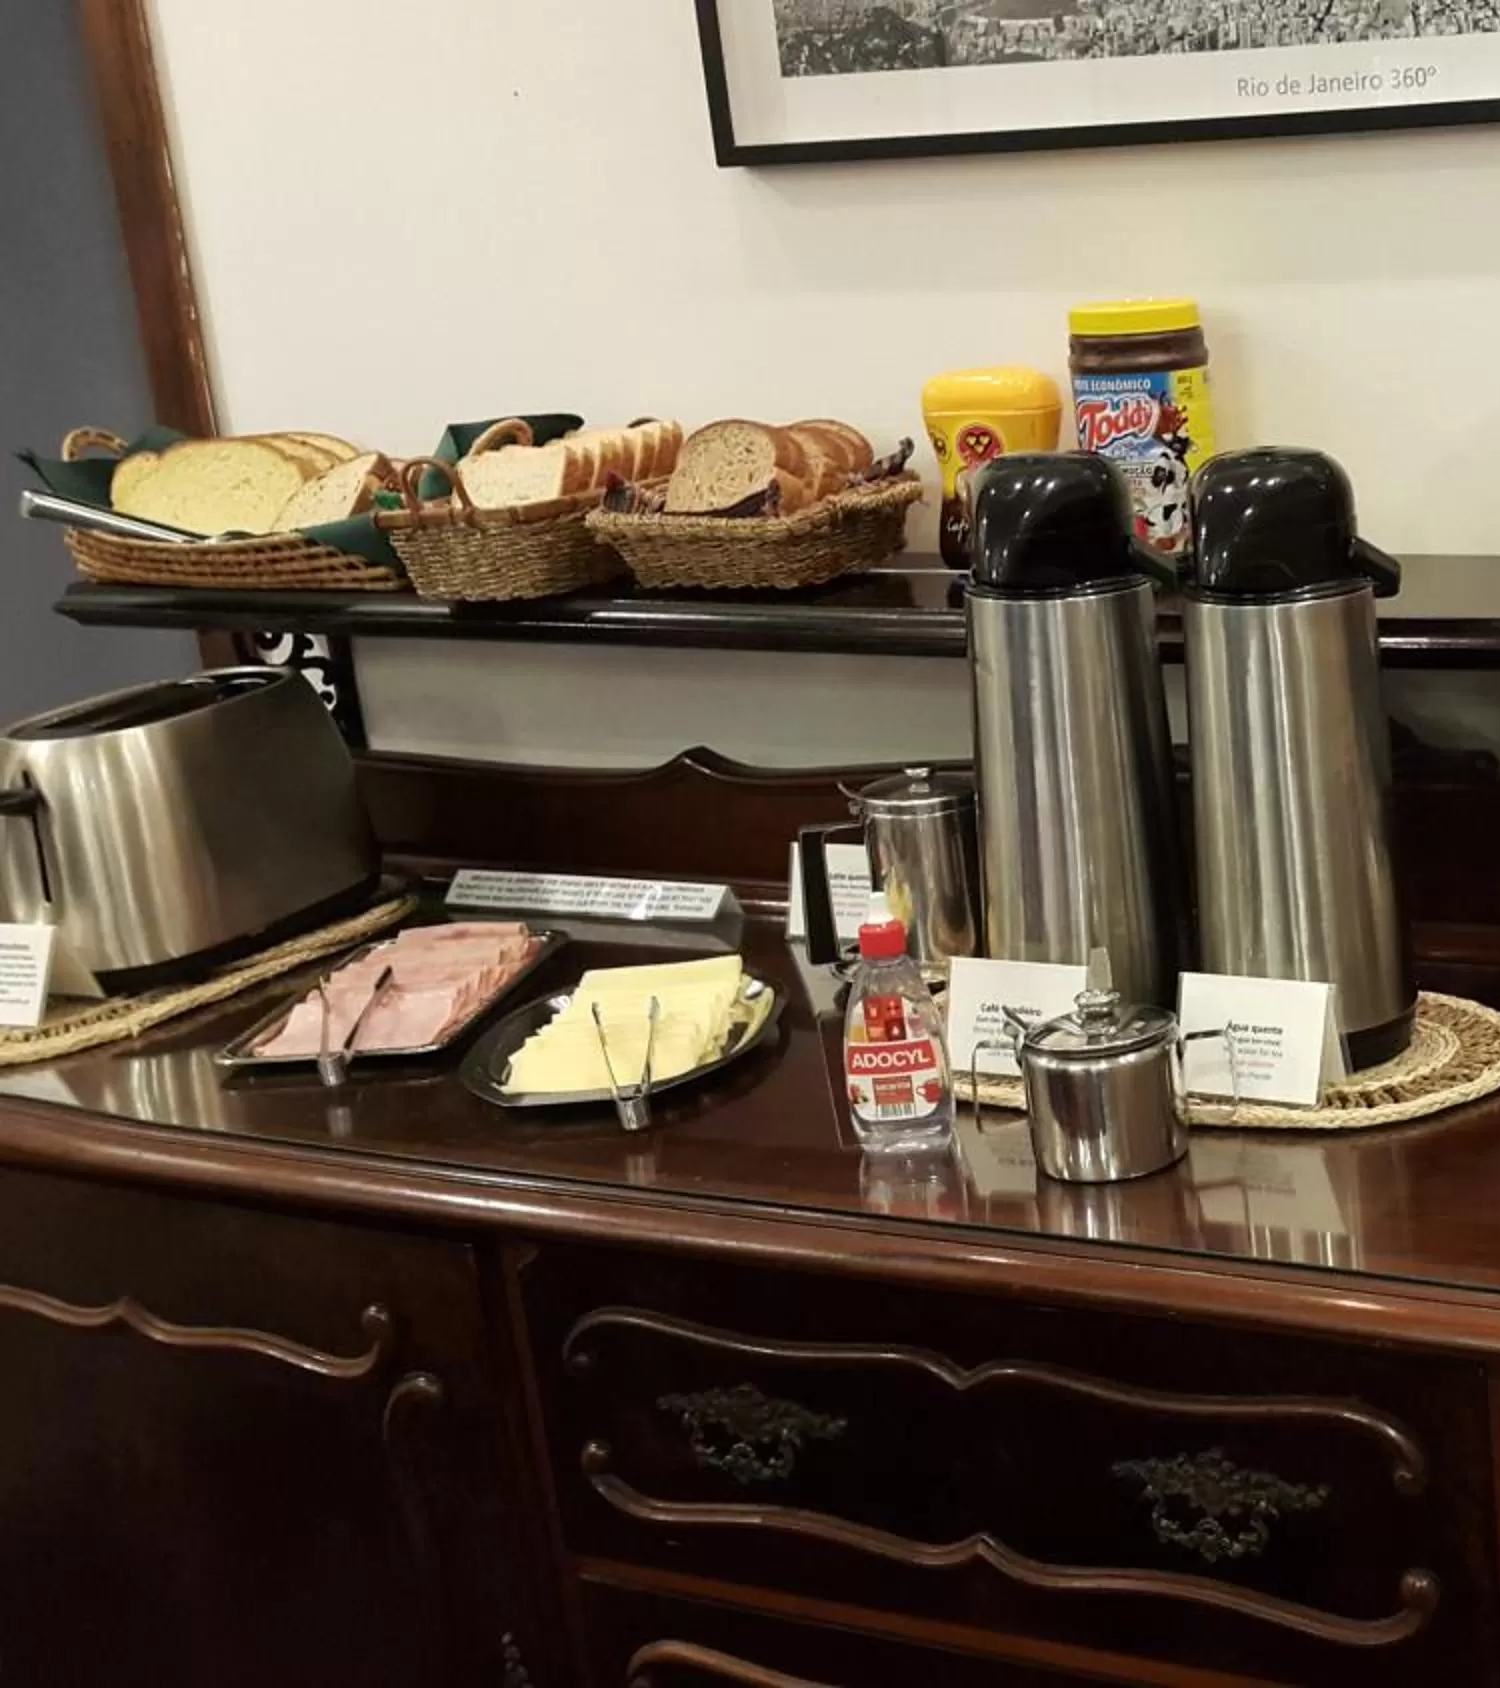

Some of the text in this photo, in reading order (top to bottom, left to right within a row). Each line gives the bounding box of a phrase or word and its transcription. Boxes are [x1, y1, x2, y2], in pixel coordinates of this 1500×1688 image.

[1237, 76, 1270, 97] Rio
[1275, 73, 1301, 96] de
[1308, 70, 1383, 94] Janeiro
[1078, 398, 1155, 453] Toddy
[852, 1047, 931, 1070] ADOCYL
